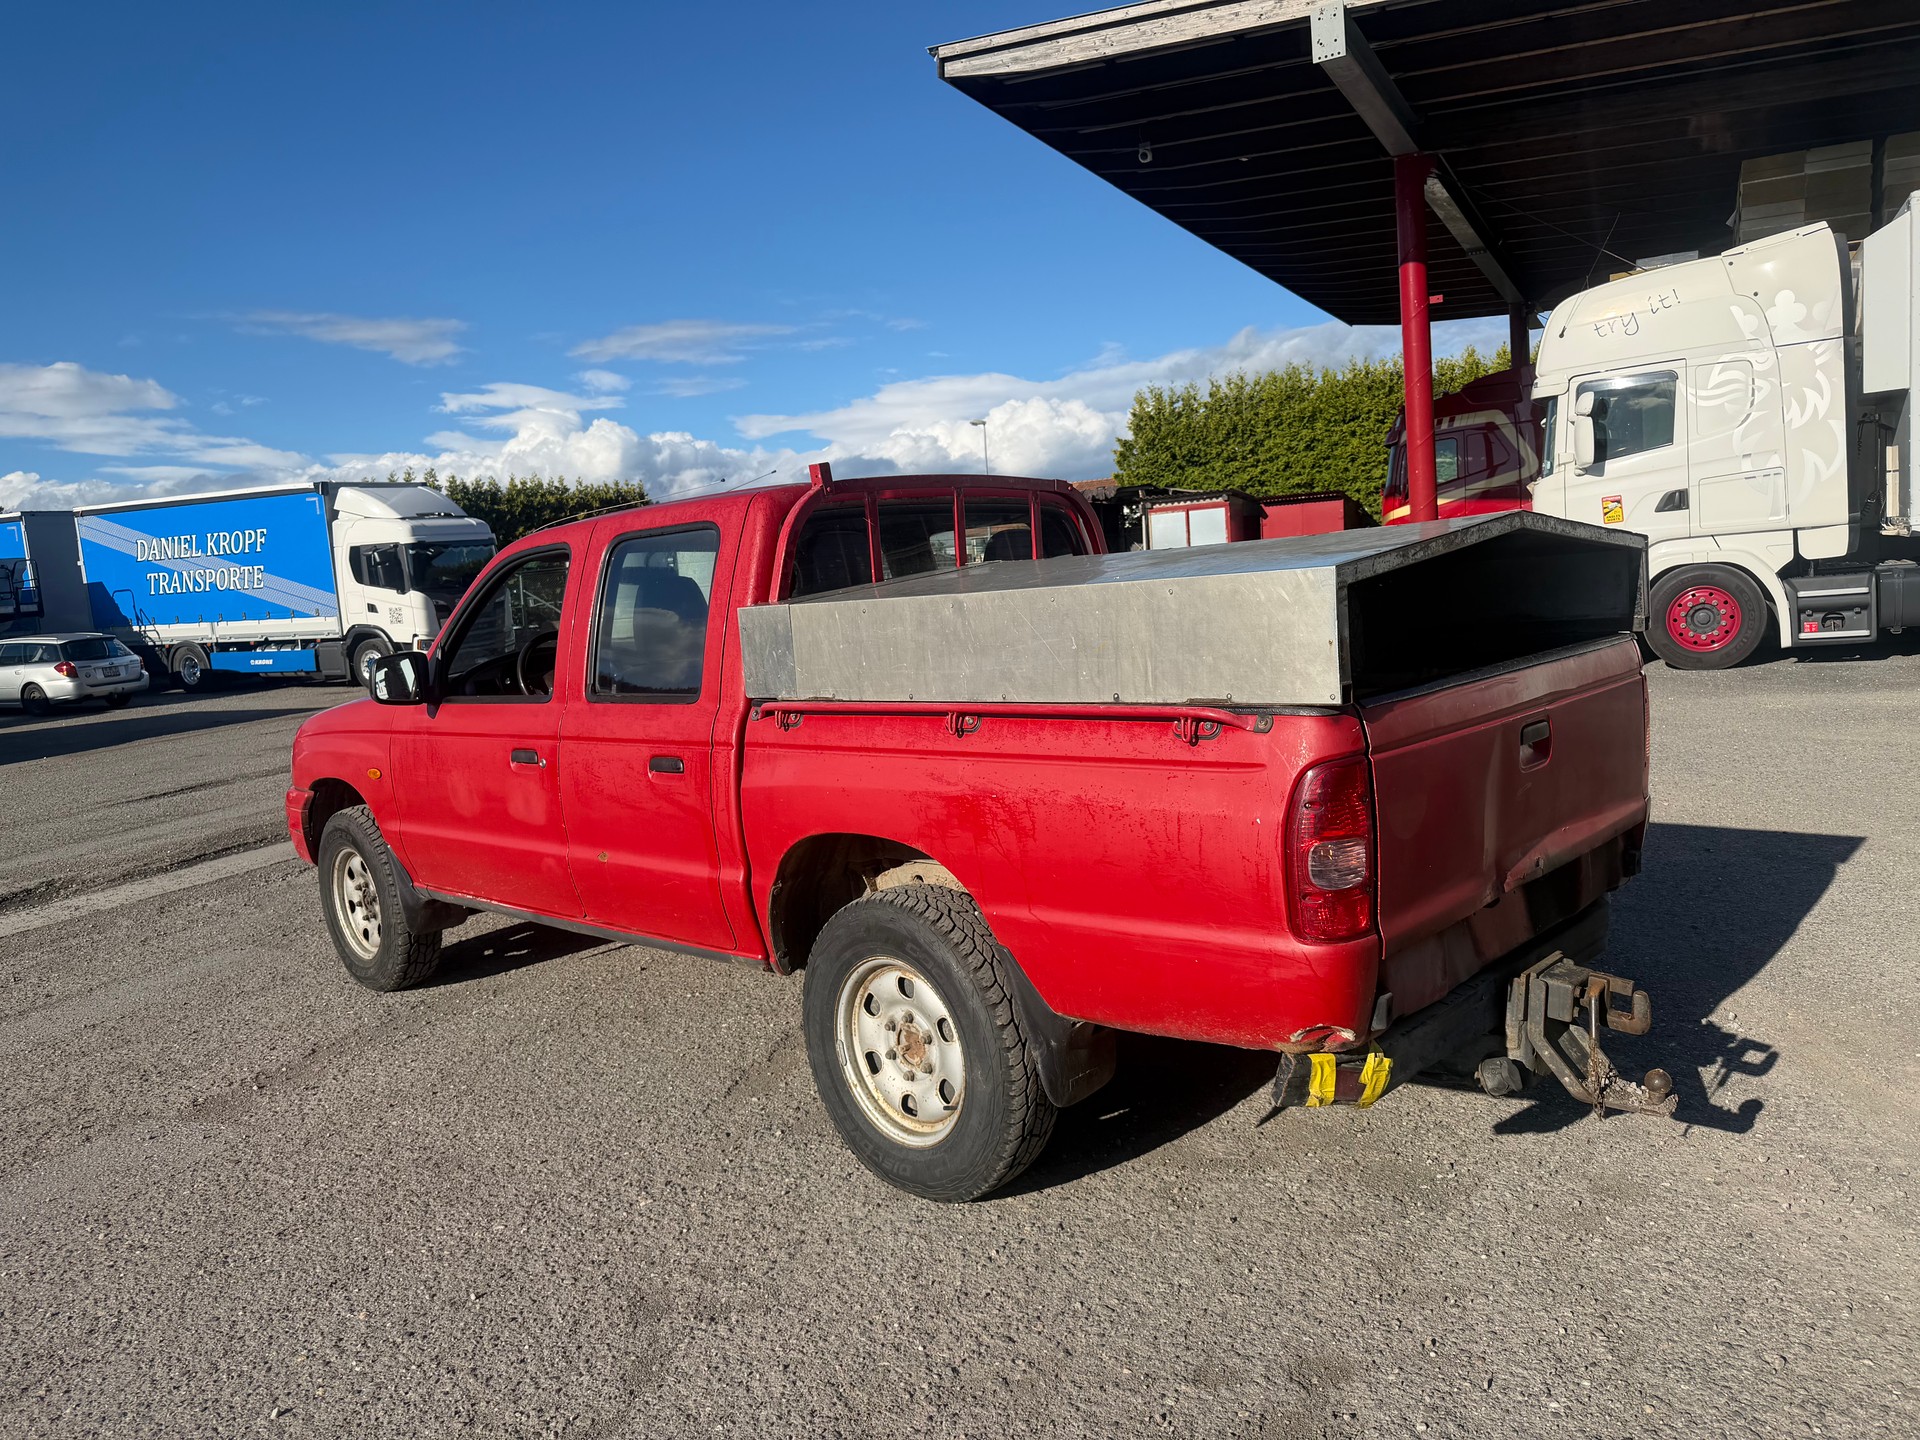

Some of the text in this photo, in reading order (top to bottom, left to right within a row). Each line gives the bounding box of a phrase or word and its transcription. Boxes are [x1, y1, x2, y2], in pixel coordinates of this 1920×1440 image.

[1594, 288, 1681, 338] try it!
[136, 528, 267, 562] DANIEL KROPF
[146, 565, 265, 595] TRANSPORTE
